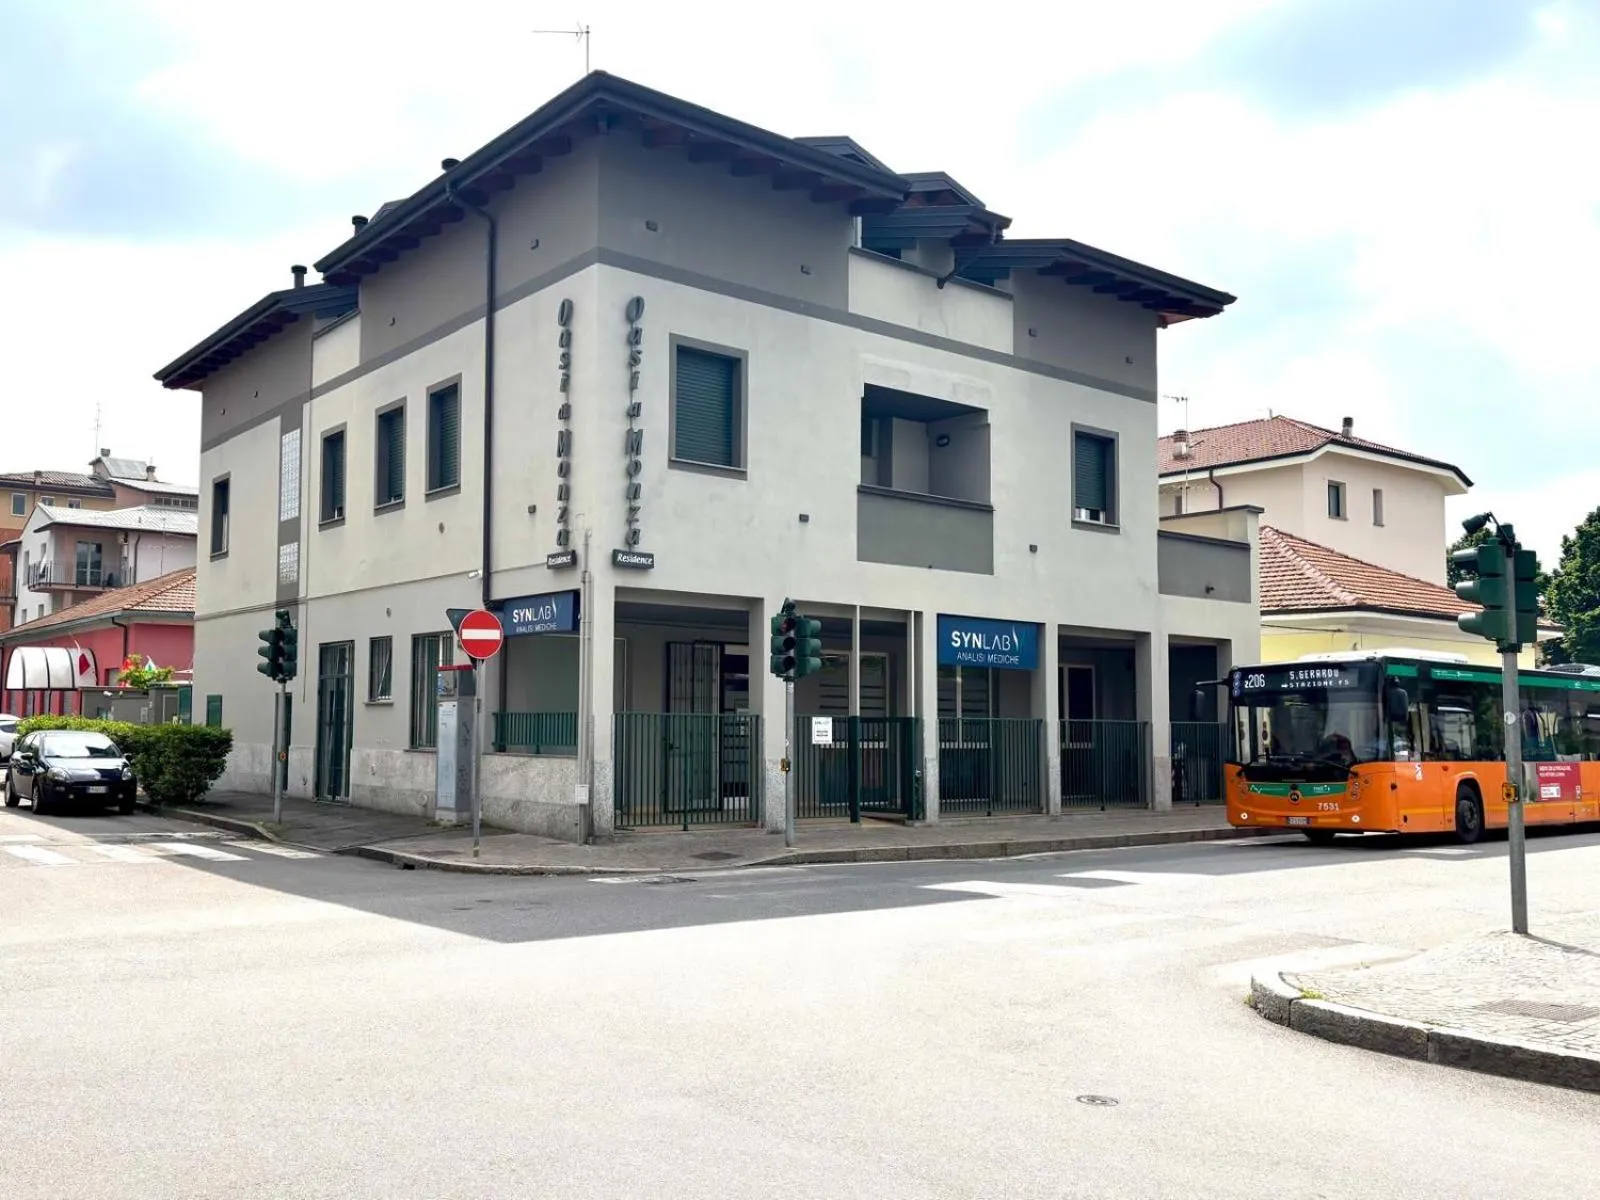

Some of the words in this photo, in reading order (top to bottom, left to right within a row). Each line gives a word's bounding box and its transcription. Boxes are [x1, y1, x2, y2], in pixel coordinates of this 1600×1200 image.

[626, 295, 645, 390] Oasi
[625, 428, 643, 545] Monza
[616, 552, 653, 564] Residence
[512, 605, 552, 623] SYNLAB
[951, 630, 1011, 651] SYNLAB
[957, 651, 985, 662] ANALISI
[987, 653, 1020, 665] MEDICHE
